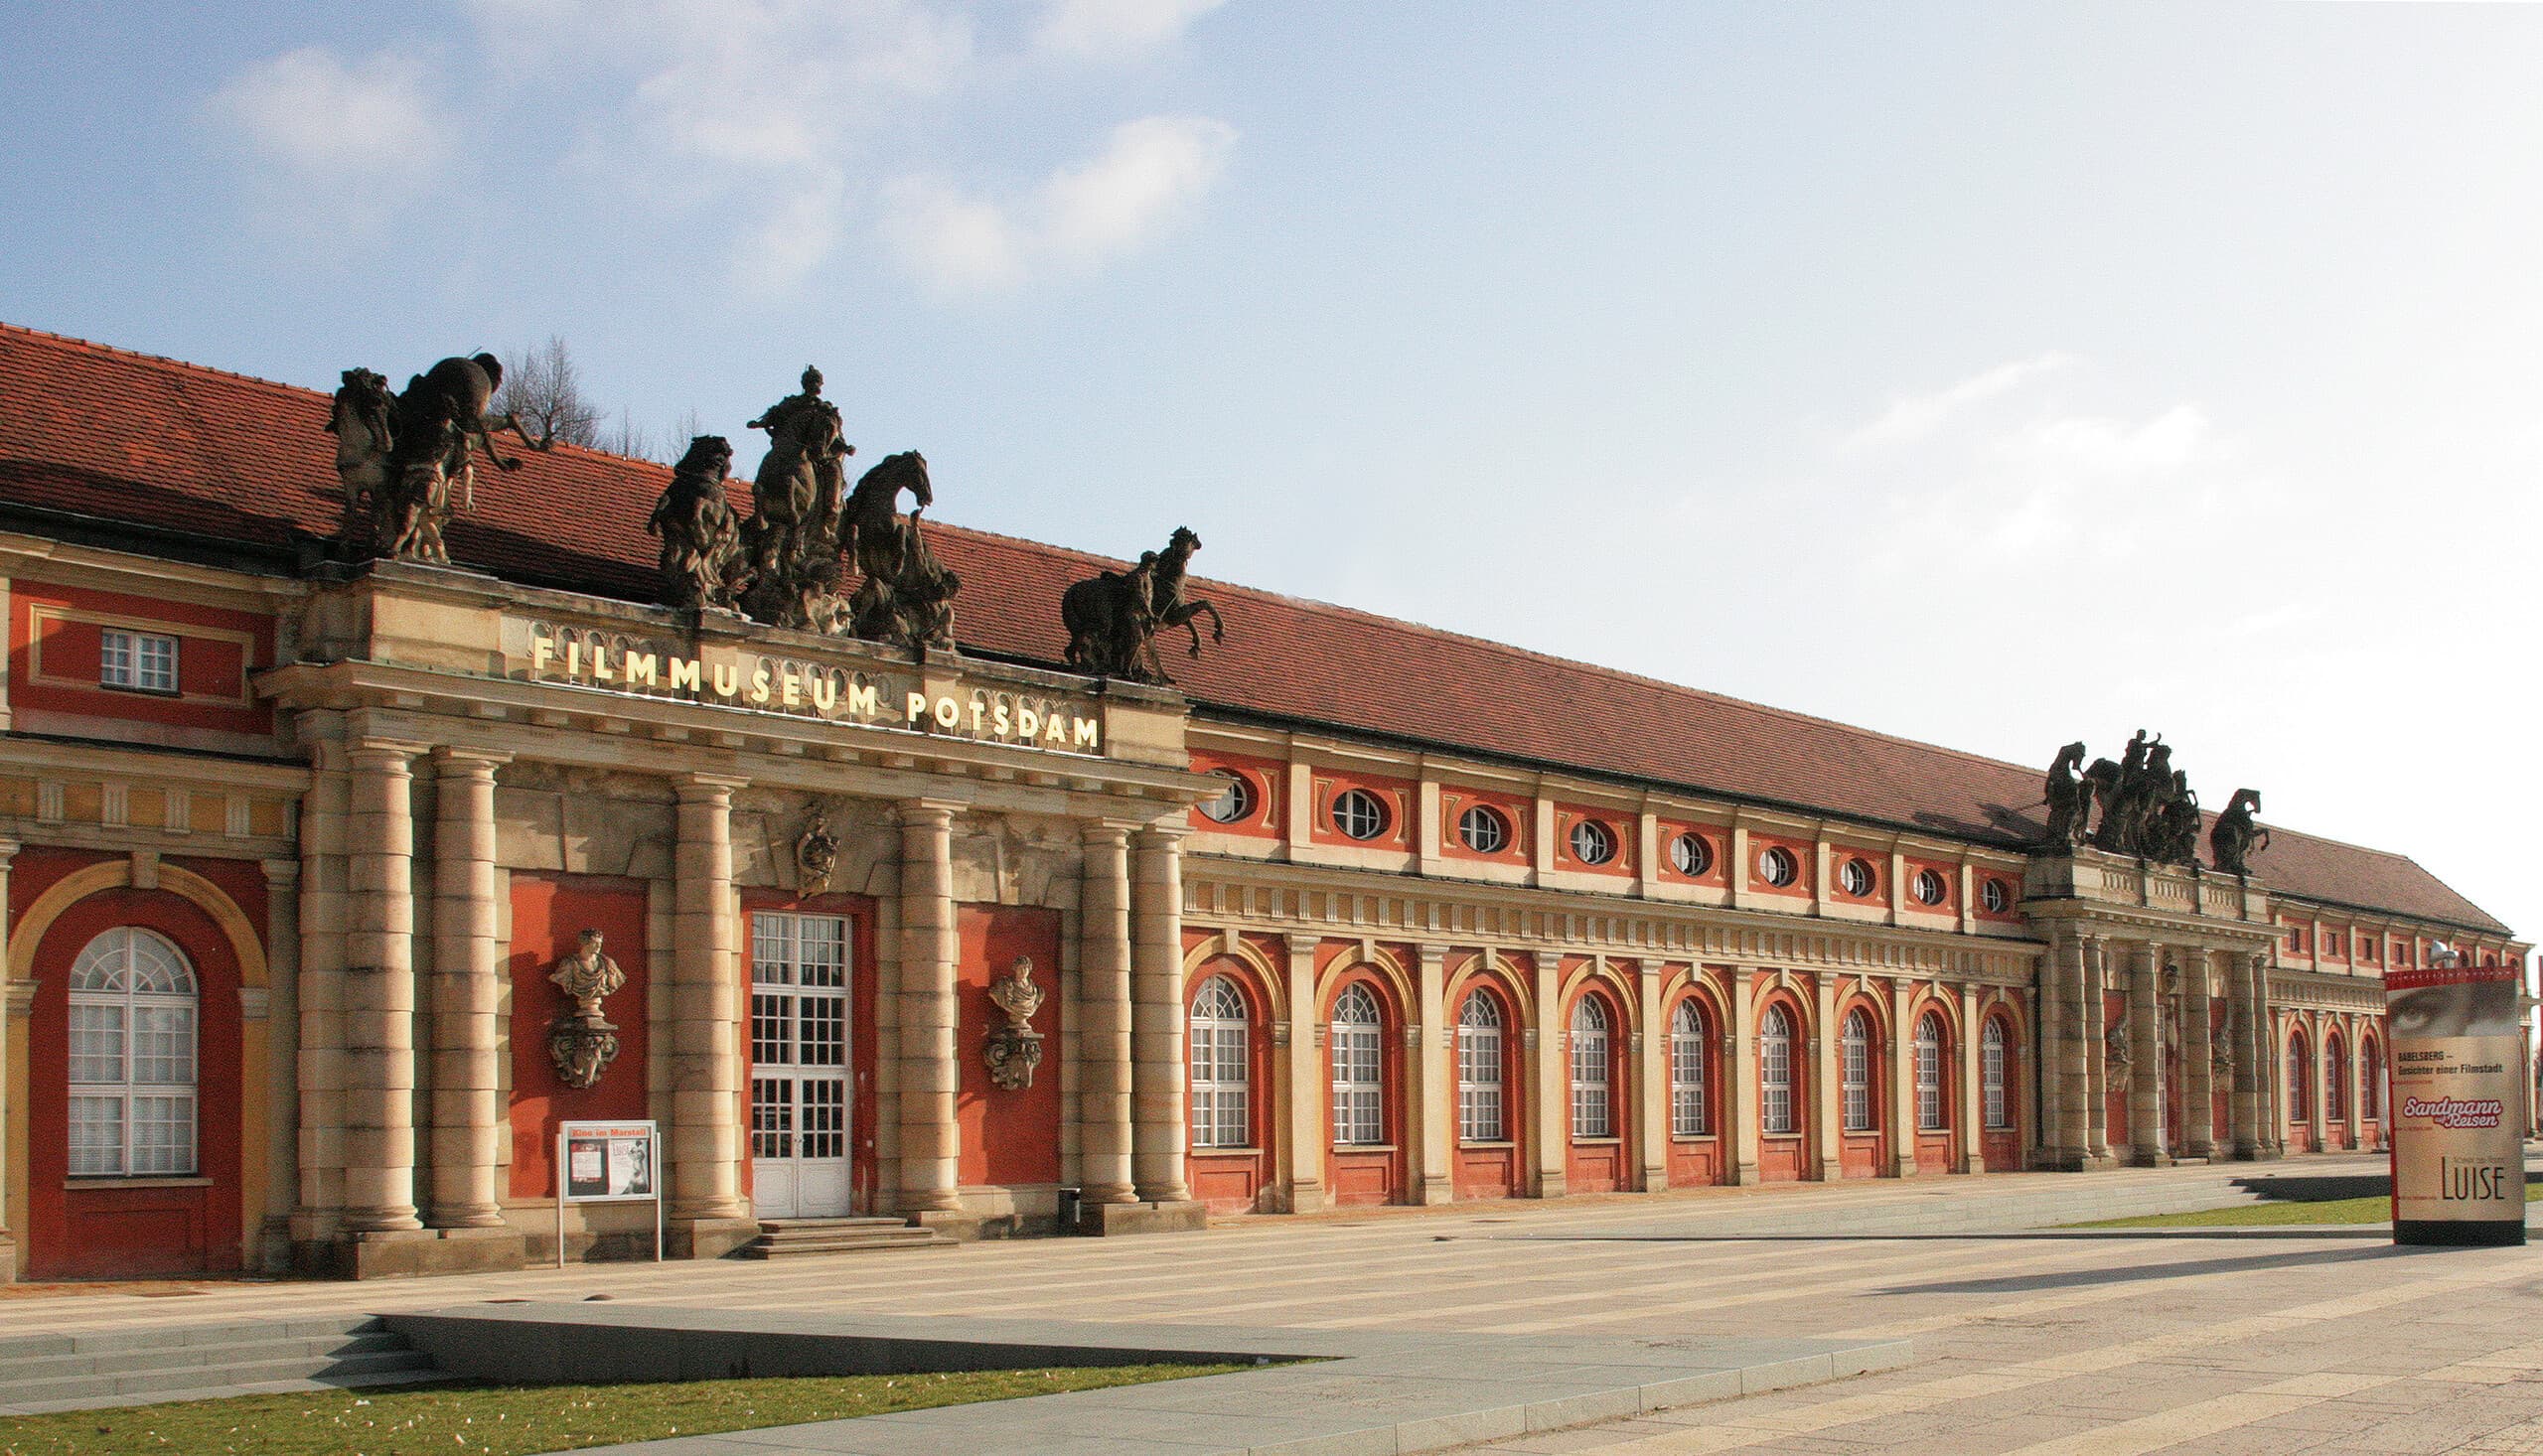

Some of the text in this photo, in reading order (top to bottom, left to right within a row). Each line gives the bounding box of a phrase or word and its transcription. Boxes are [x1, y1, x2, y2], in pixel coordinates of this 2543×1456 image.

[533, 636, 1099, 748] FILMMUSEUM POTSDAM
[2398, 1051, 2445, 1062] BABELSBERG
[2398, 1063, 2503, 1076] Gesichter einer Filmstadt
[2403, 1096, 2502, 1117] Sandmann
[2444, 1112, 2498, 1128] Reisen
[2442, 1156, 2505, 1201] LUISE
